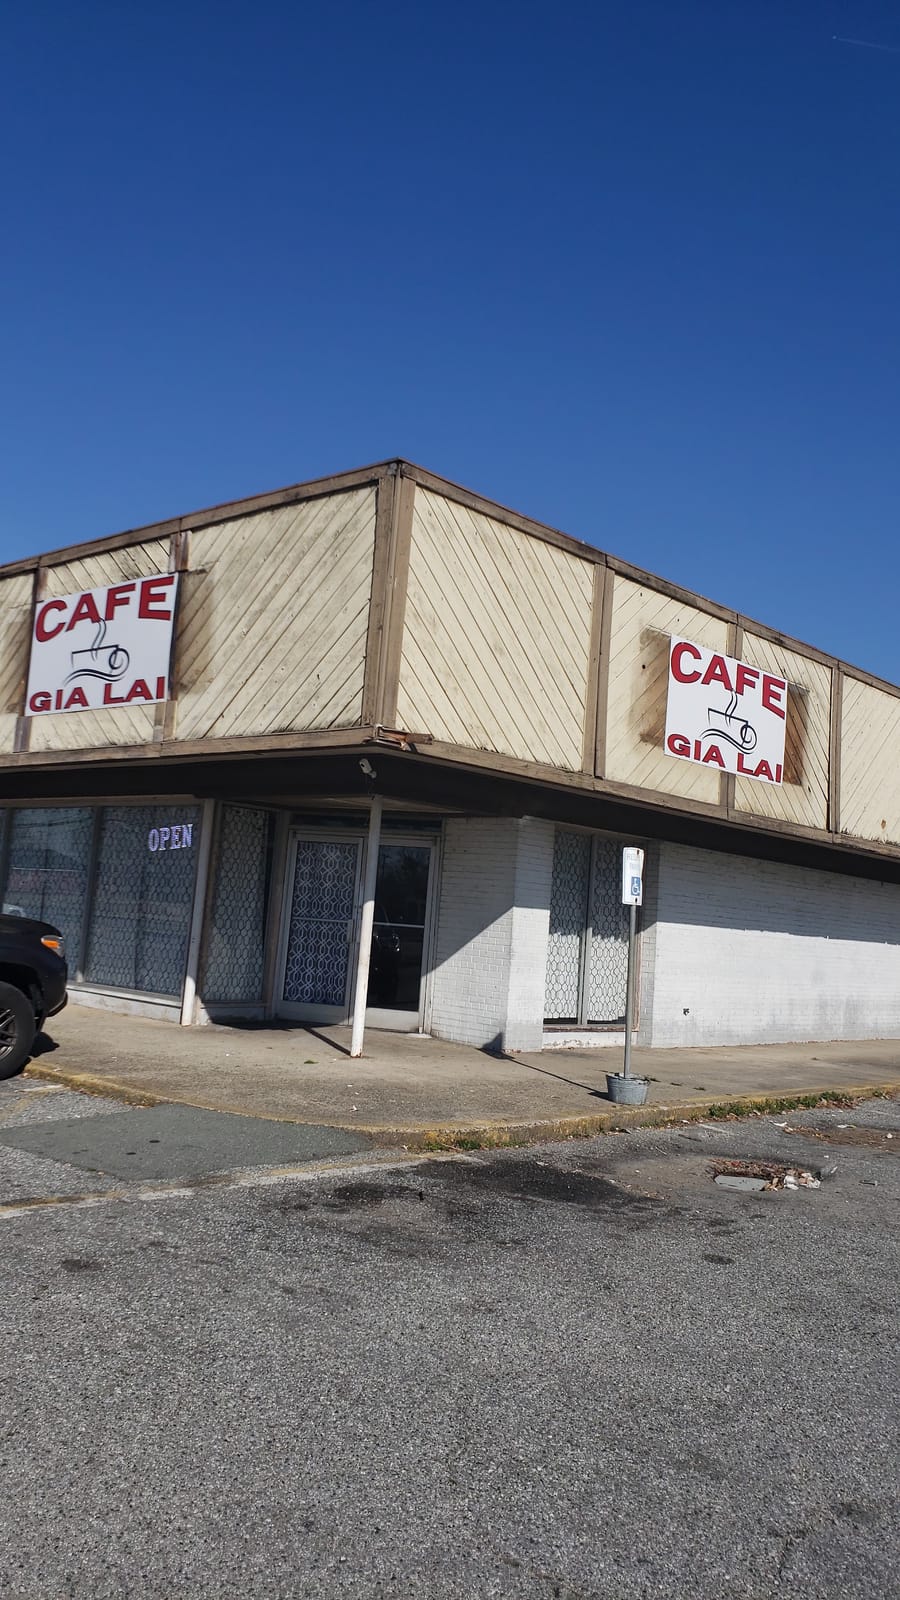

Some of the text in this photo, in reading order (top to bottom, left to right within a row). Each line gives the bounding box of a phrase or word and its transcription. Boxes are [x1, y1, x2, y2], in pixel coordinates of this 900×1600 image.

[35, 576, 174, 642] CAFE
[29, 676, 165, 712] GIA LAI
[671, 642, 785, 720] CAFE
[667, 734, 783, 783] GIA LAI
[148, 824, 193, 852] OPEN
